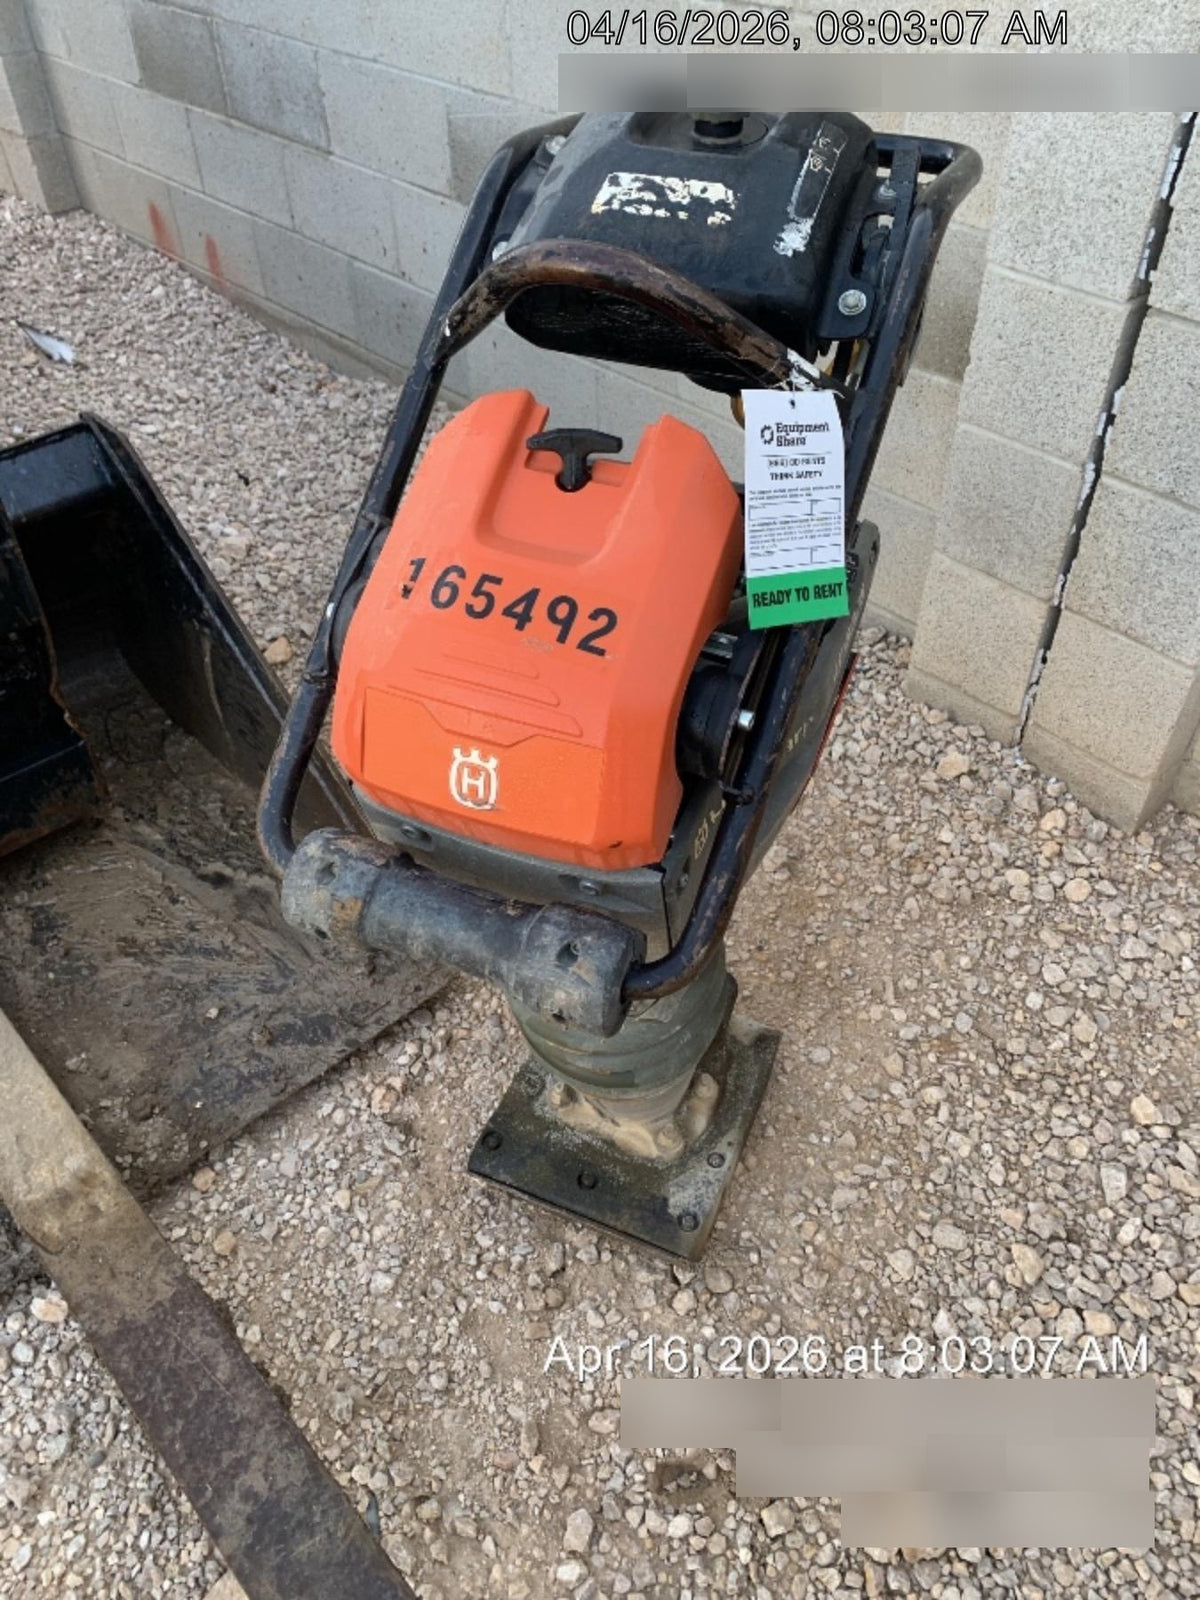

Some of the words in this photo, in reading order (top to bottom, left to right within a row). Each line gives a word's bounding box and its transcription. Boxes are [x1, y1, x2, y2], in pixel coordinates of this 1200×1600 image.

[776, 422, 829, 436] Equipment
[776, 435, 807, 447] Share
[752, 588, 792, 608] READY
[795, 586, 810, 602] TO
[813, 582, 843, 600] RENT
[401, 557, 618, 657] 165492
